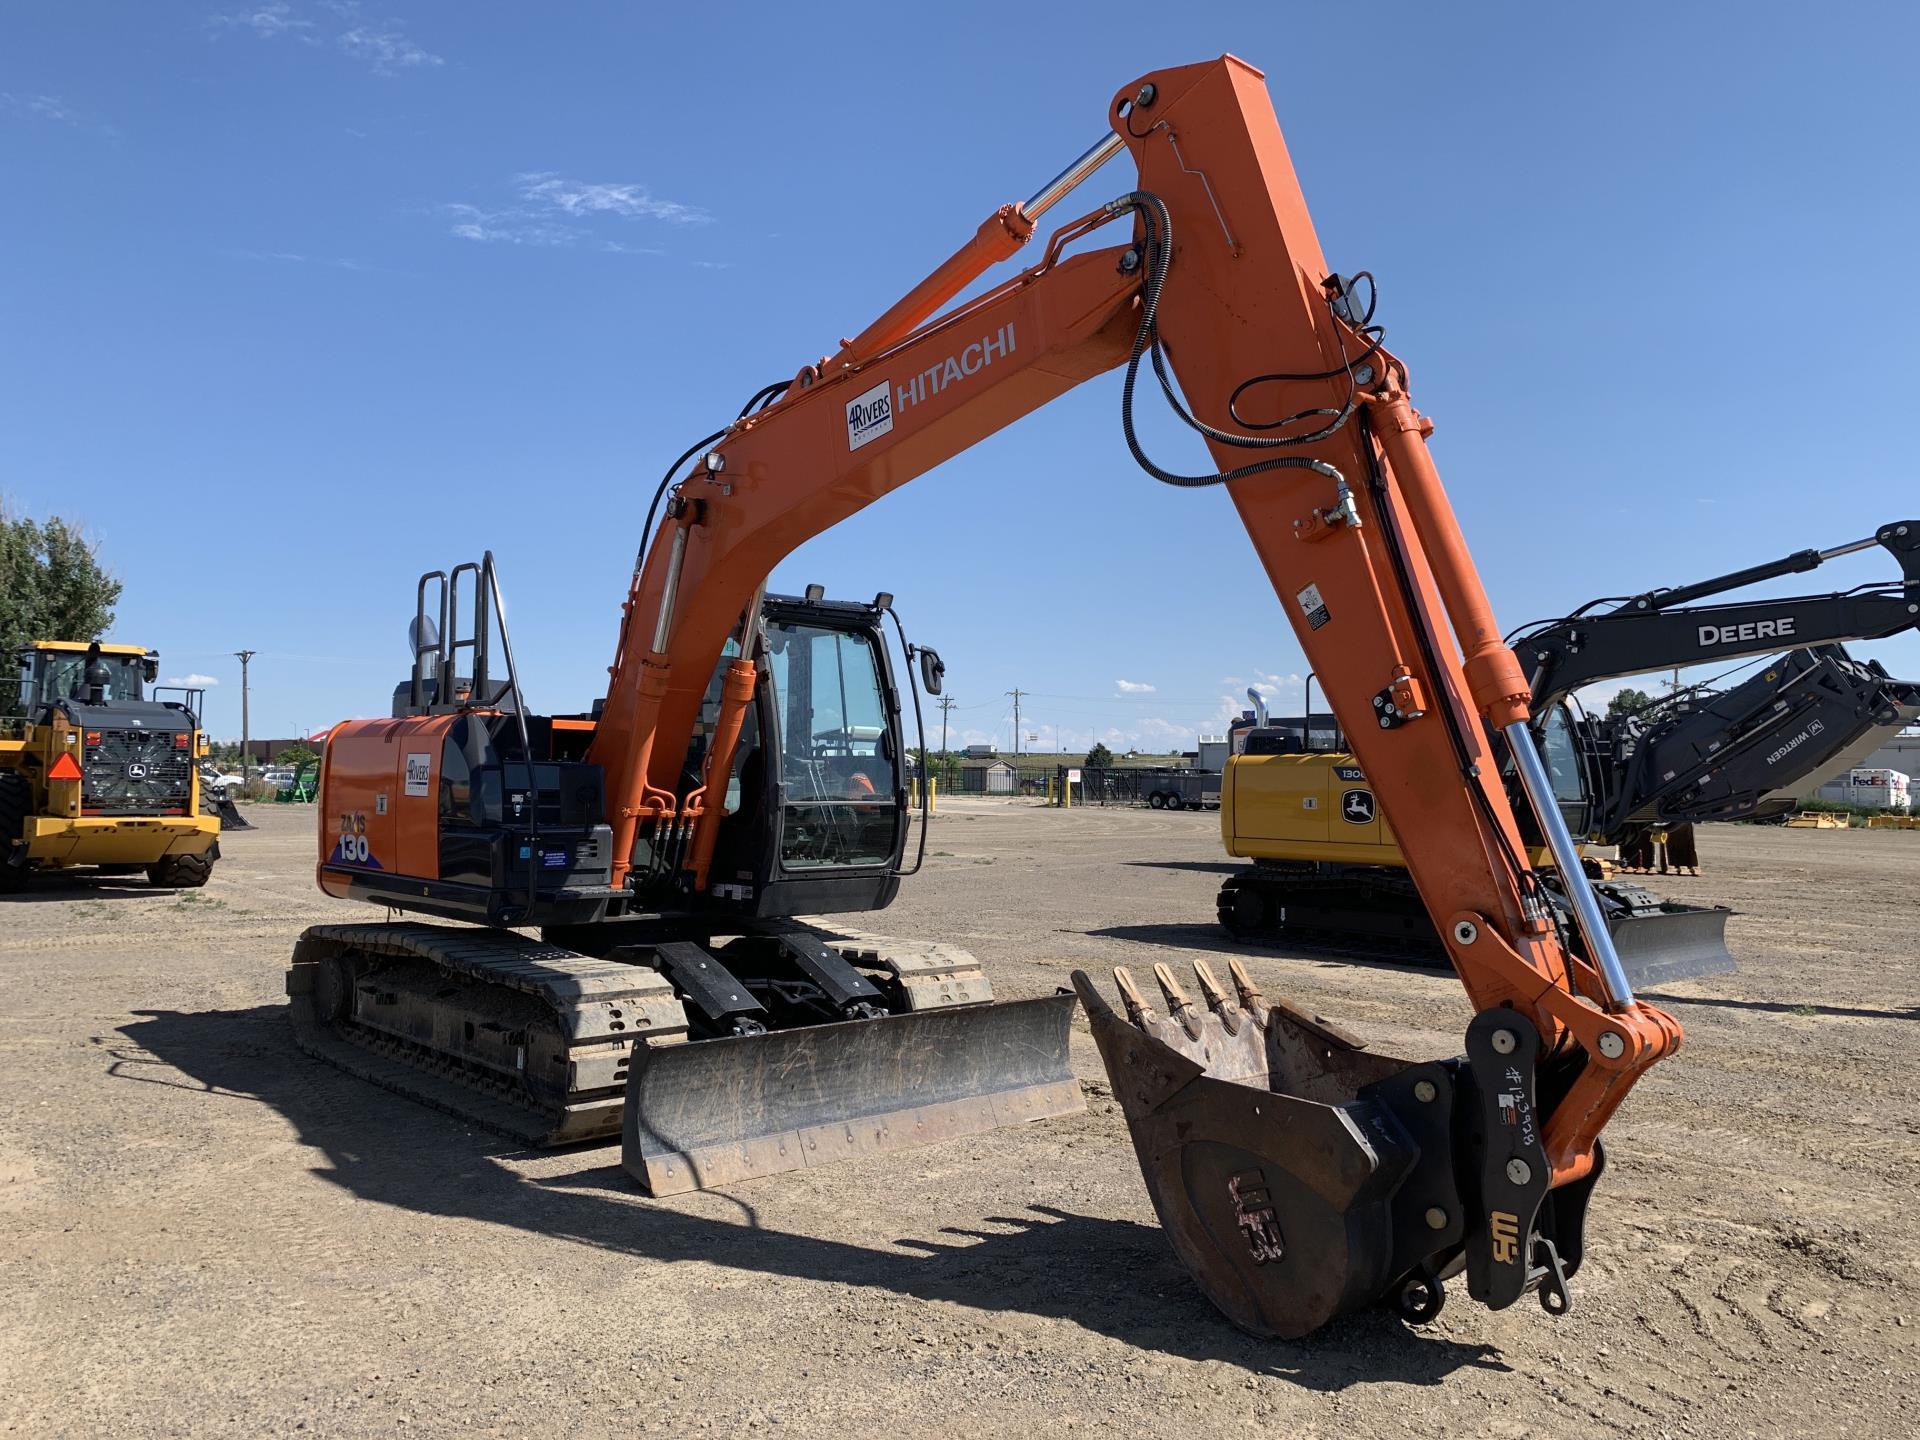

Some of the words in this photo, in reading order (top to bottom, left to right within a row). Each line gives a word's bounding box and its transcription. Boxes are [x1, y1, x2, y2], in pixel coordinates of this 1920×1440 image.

[896, 322, 1017, 413] HITACHI
[1698, 617, 1796, 647] DEERE
[1766, 731, 1810, 765] WIRTGEN
[1852, 775, 1888, 786] FedEx
[339, 834, 369, 862] 130
